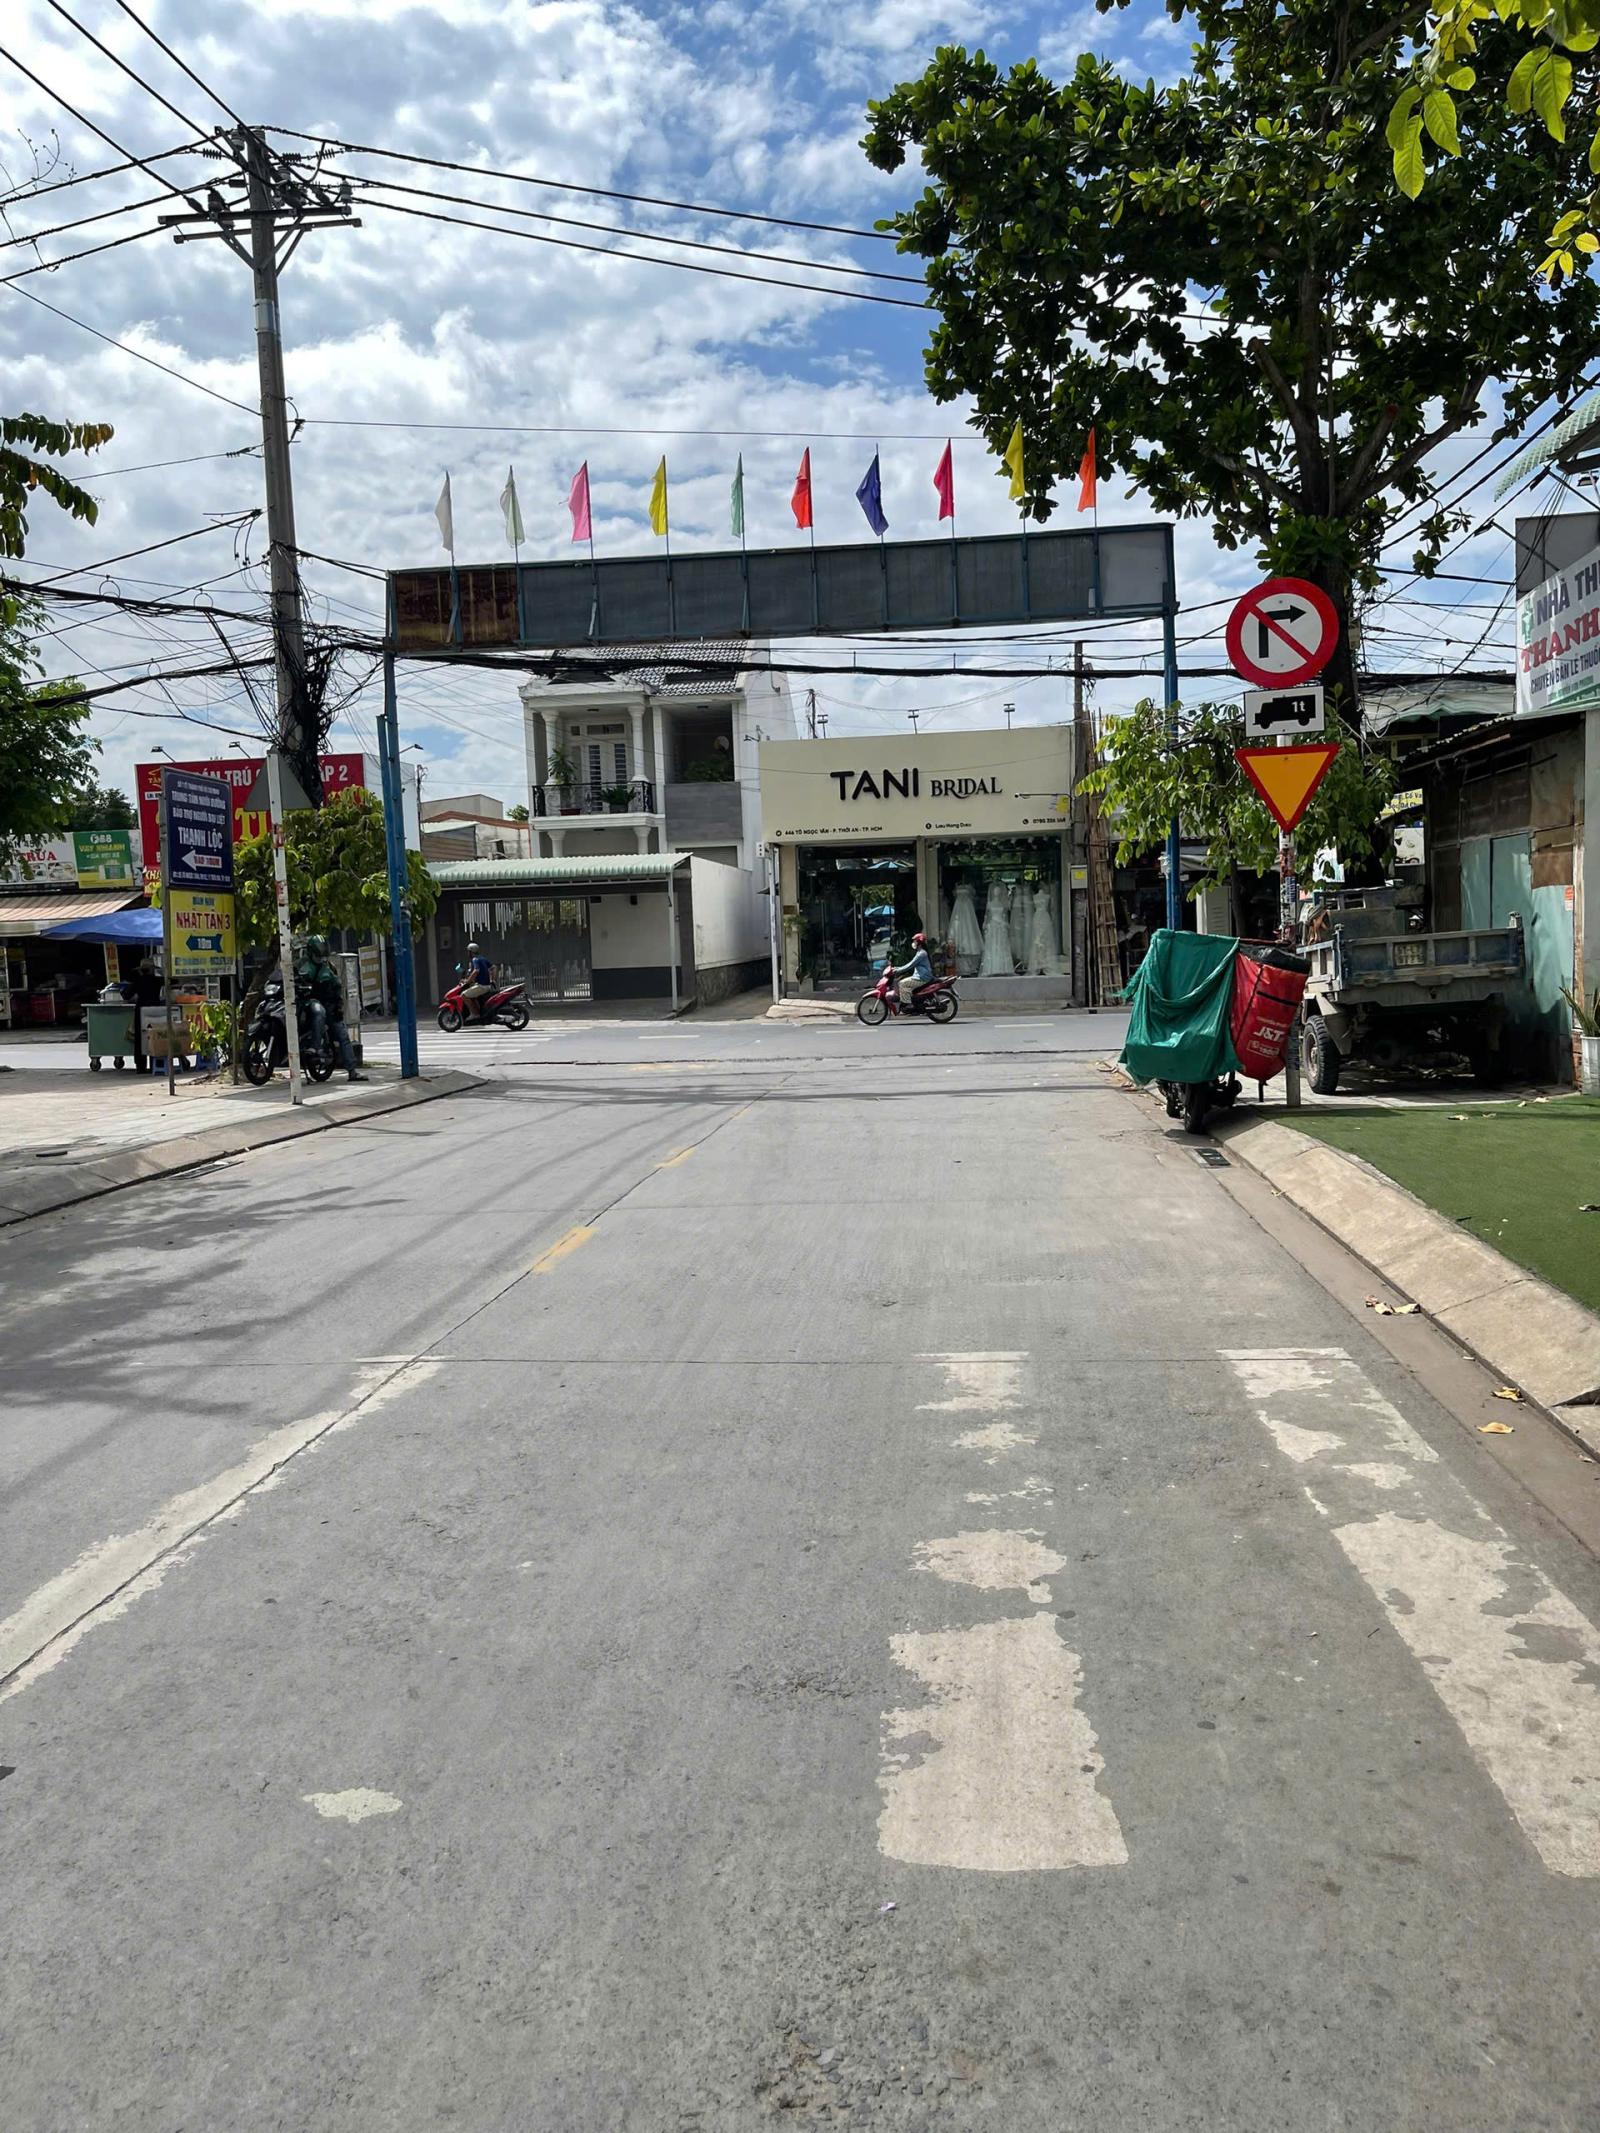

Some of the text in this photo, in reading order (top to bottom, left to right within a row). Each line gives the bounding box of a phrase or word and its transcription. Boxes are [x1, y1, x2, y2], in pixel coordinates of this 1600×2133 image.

[1536, 560, 1600, 626] NHÀ TH
[829, 767, 1003, 800] TANI BRIDAL
[178, 826, 223, 852] THẠNH LỘC
[224, 913, 231, 930] 3
